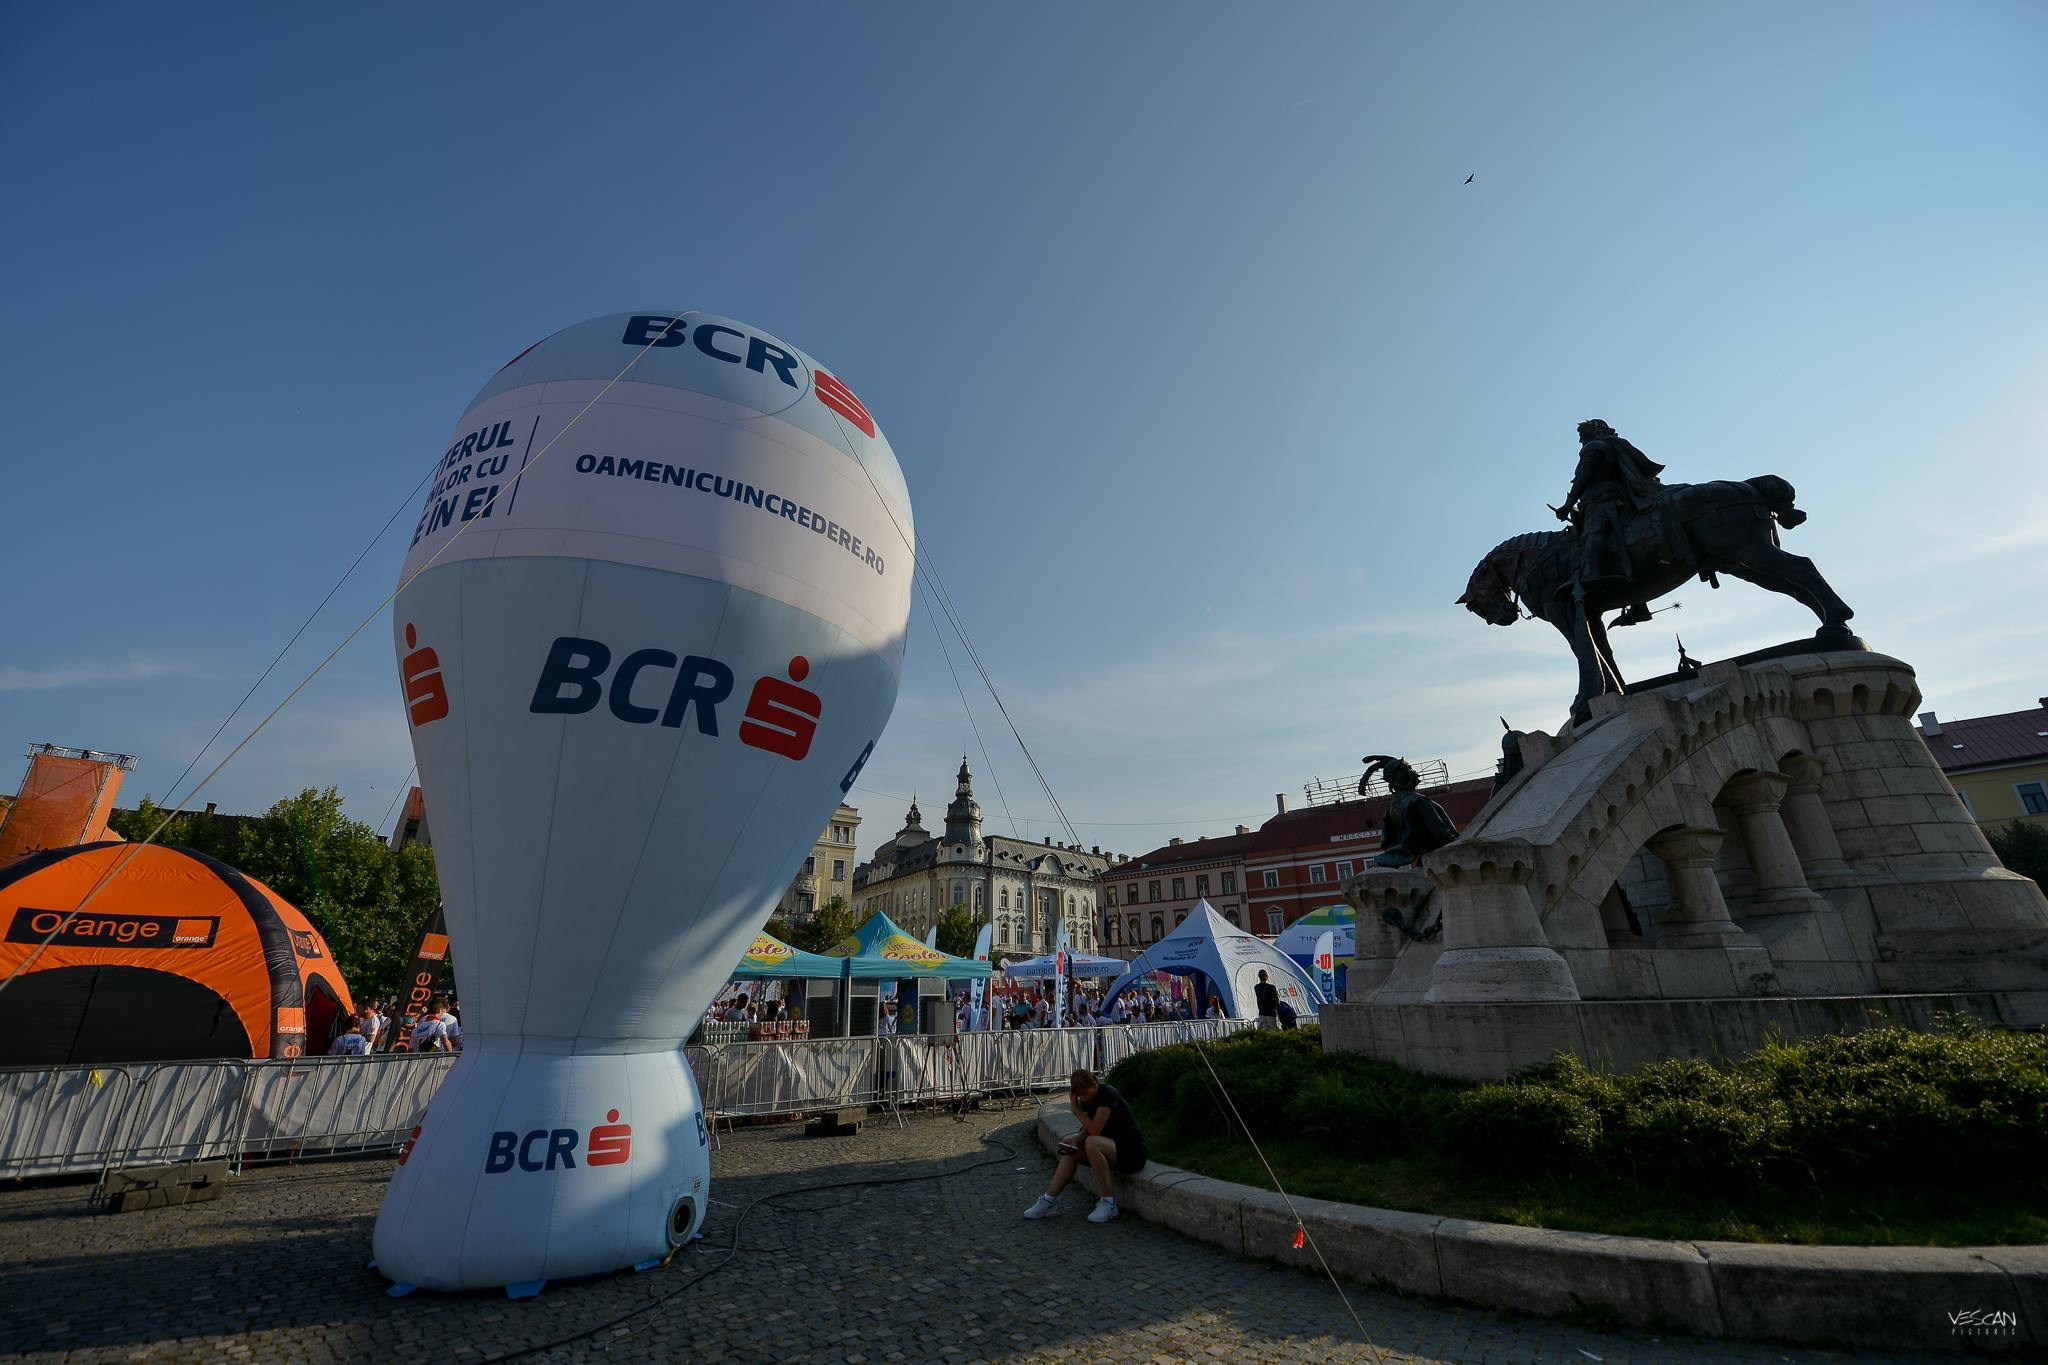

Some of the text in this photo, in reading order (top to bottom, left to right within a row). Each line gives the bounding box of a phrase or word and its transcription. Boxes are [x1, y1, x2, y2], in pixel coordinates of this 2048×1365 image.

[622, 315, 799, 389] BCR
[476, 454, 510, 479] CU
[460, 485, 500, 521] EI
[575, 453, 885, 576] OAMENICUINCREDERE.RO
[529, 637, 734, 738] BCR
[31, 913, 160, 943] Orange
[175, 935, 205, 943] orange
[1321, 972, 1333, 1004] BCR
[485, 1128, 579, 1174] BCR
